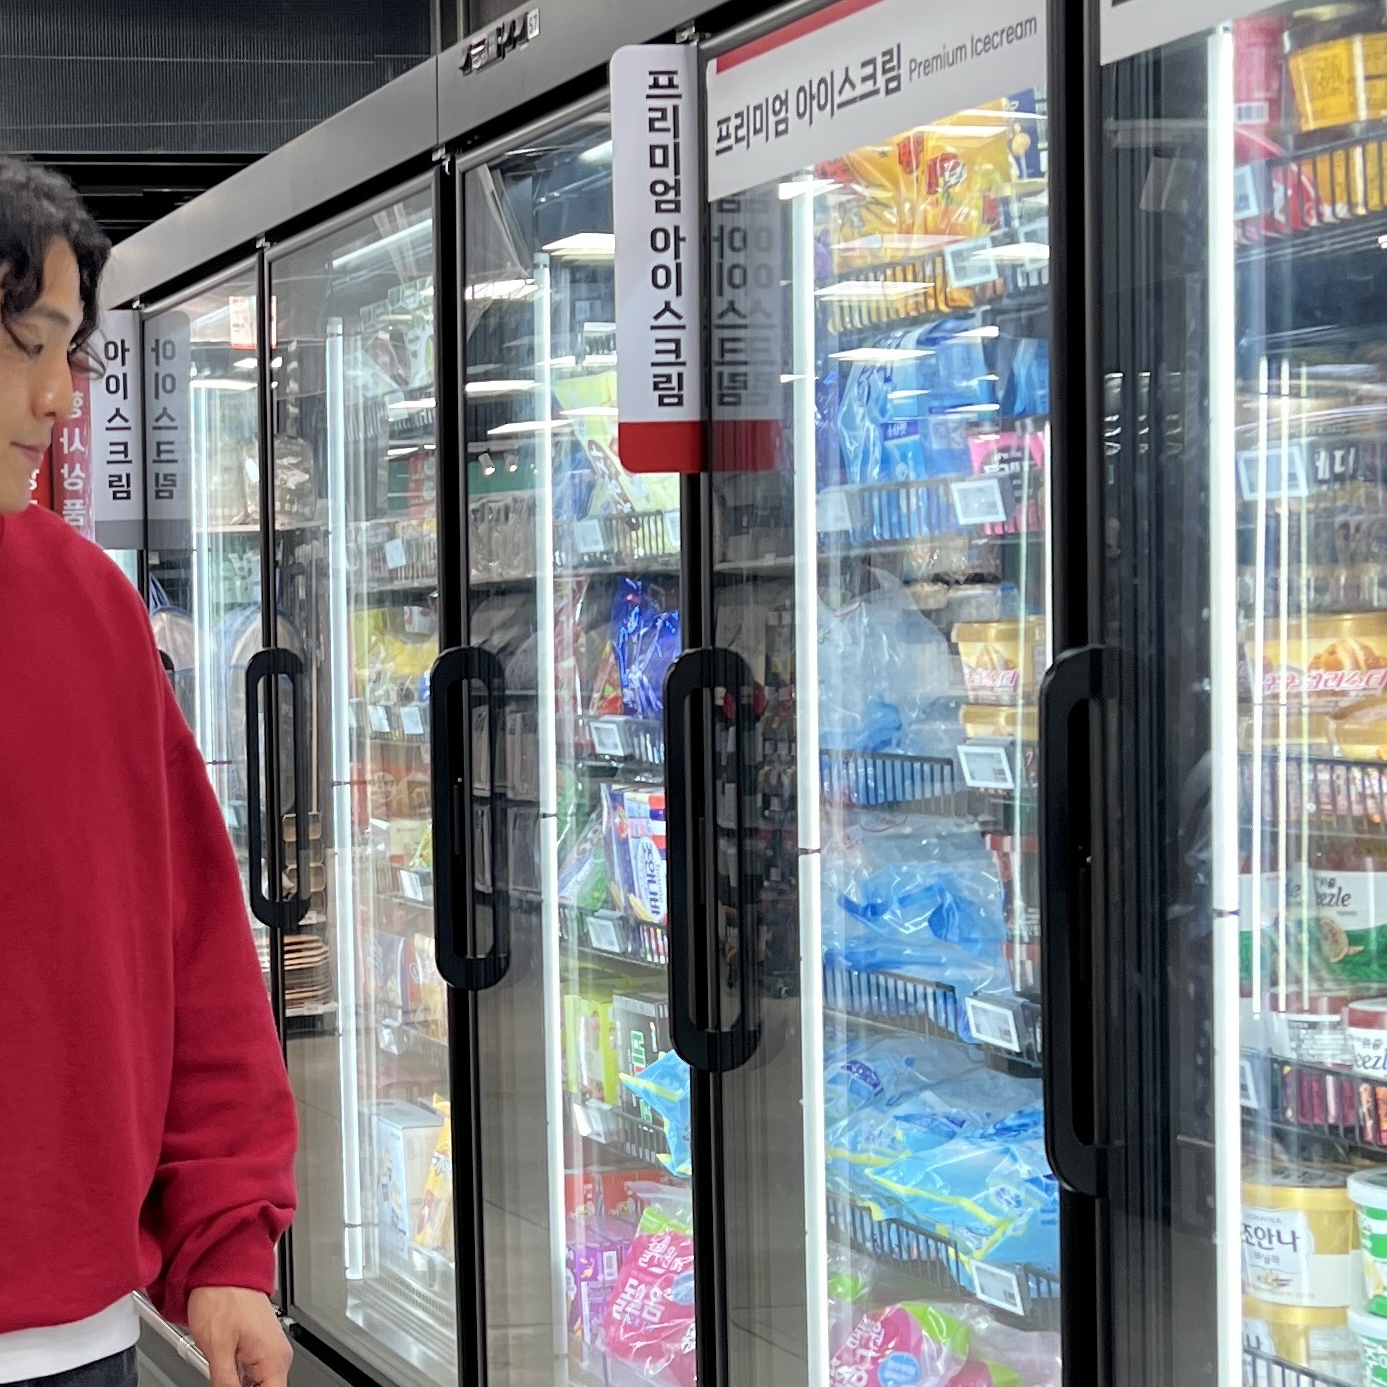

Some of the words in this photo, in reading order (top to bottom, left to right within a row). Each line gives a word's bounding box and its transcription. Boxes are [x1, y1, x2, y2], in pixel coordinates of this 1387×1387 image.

[715, 88, 789, 156] 프리미엄
[796, 43, 902, 127] 아이스크림
[908, 42, 967, 83] Premium
[970, 15, 1038, 60] Icecream
[646, 69, 683, 215] 프리미엄
[650, 224, 687, 408] 아이스크림
[103, 338, 133, 501] 아이스크림
